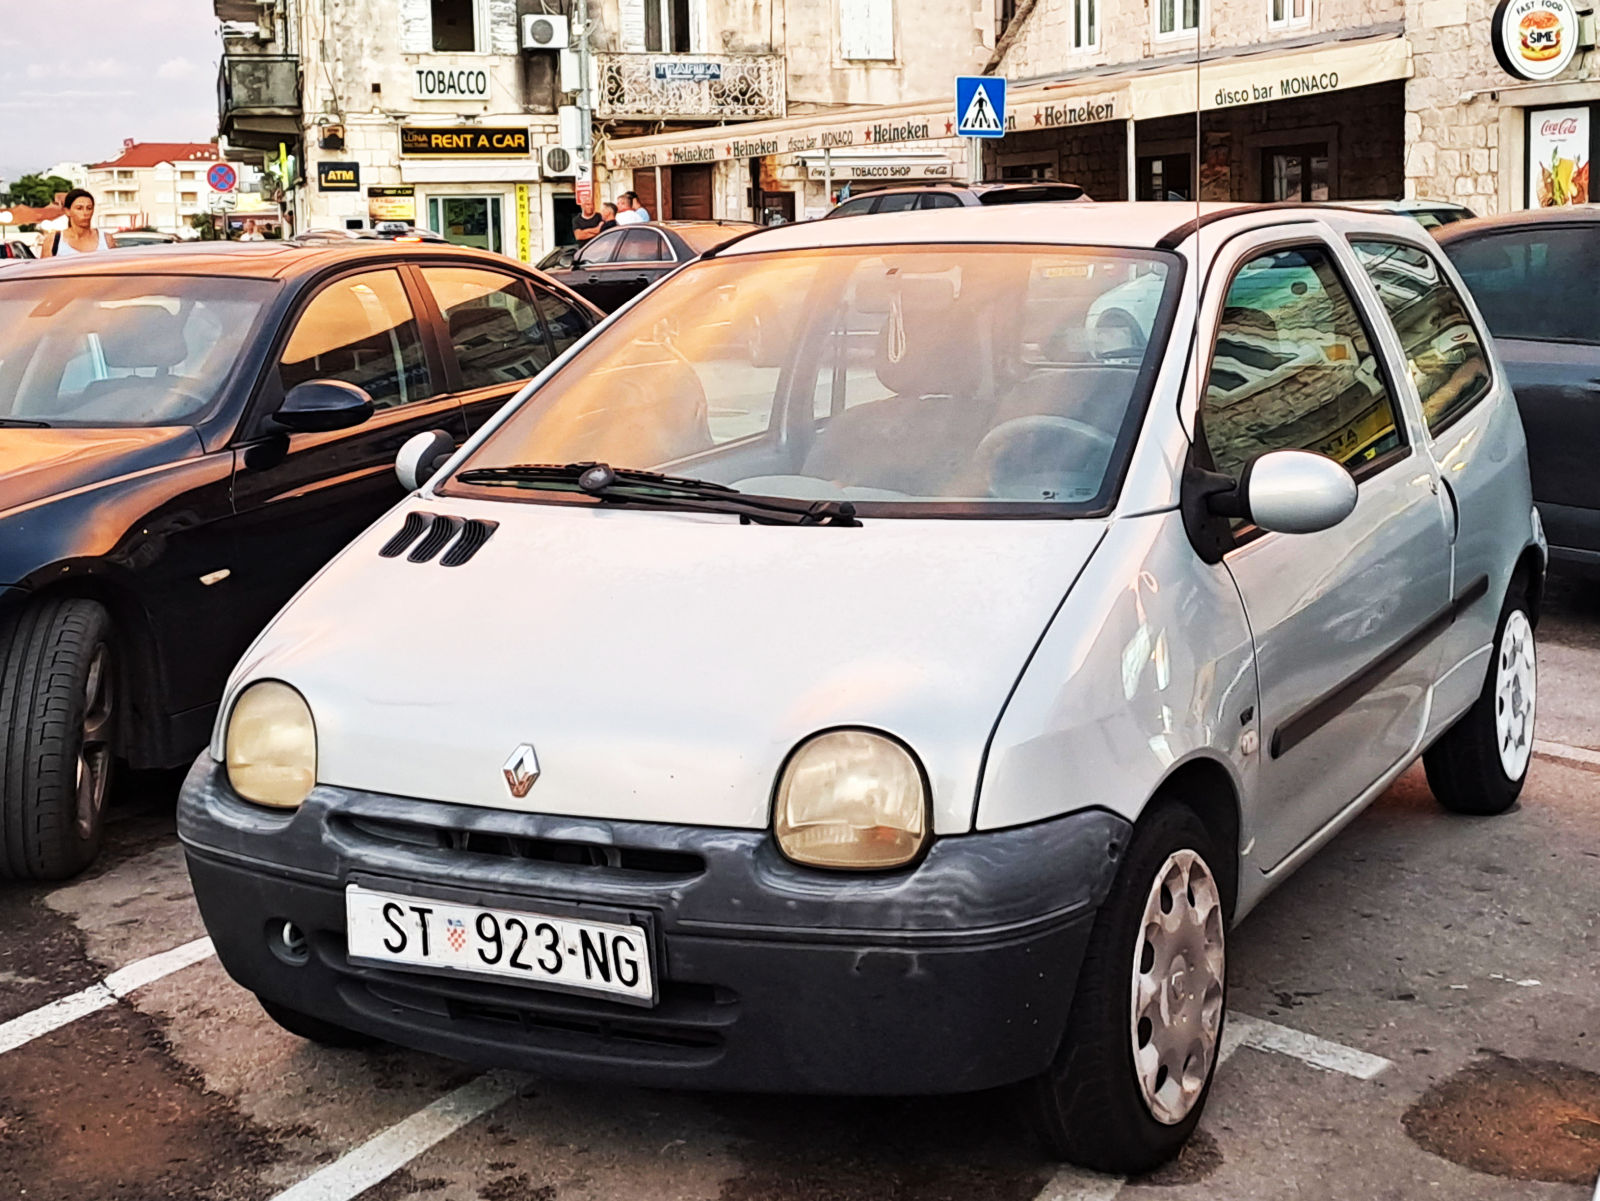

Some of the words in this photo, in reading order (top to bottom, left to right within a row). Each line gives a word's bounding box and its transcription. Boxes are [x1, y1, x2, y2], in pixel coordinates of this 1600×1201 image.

[1516, 1, 1535, 15] FAST
[1542, 0, 1563, 11] FOOD
[416, 70, 487, 94] TOBACCO
[1215, 89, 1249, 105] disco
[1252, 84, 1273, 100] bar
[1280, 72, 1339, 95] MONACO
[1044, 101, 1114, 126] Heineken
[431, 134, 474, 148] RENT
[477, 134, 490, 148] A
[493, 134, 525, 148] CAR
[788, 137, 804, 152] disco
[807, 133, 817, 149] bar
[822, 130, 853, 146] MONACO
[873, 121, 929, 142] Heineken
[672, 145, 715, 163] Heineken
[733, 139, 778, 157] Heineken
[327, 170, 354, 180] ATM
[851, 167, 888, 177] TOBACCO
[890, 166, 911, 176] SHOP
[518, 186, 526, 217] RENT
[382, 902, 433, 956] ST
[475, 912, 639, 987] 923-NG
